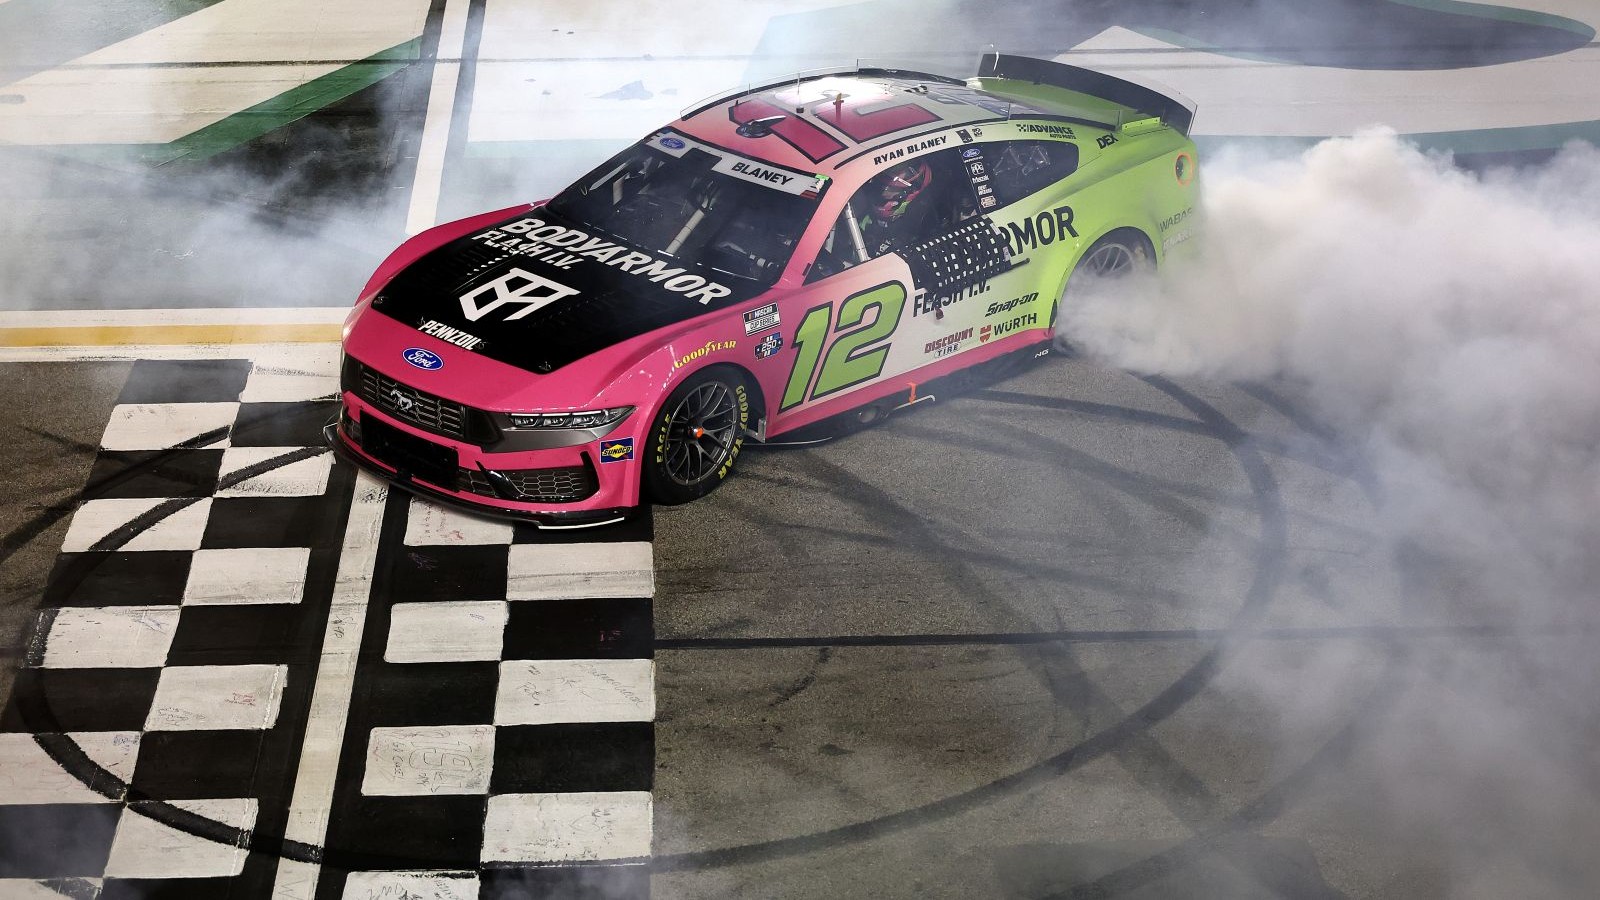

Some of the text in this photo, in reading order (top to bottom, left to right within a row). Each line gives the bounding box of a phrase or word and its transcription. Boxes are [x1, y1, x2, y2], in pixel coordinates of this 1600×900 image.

[1027, 124, 1074, 135] ADVANCE
[1095, 132, 1119, 149] DEX
[873, 148, 905, 165] RYAN
[906, 135, 947, 154] BLANEY
[731, 161, 794, 186] BLANEY
[499, 218, 732, 305] BODYARMOR
[984, 292, 1039, 317] Snap-on
[418, 320, 481, 351] PENNZOIL
[777, 279, 907, 415] 12
[924, 327, 974, 353] DISCOUNT
[406, 349, 439, 369] Ford
[674, 340, 737, 369] GOODYEAR
[937, 343, 959, 357] TIRE
[601, 445, 633, 457] SUNOCO
